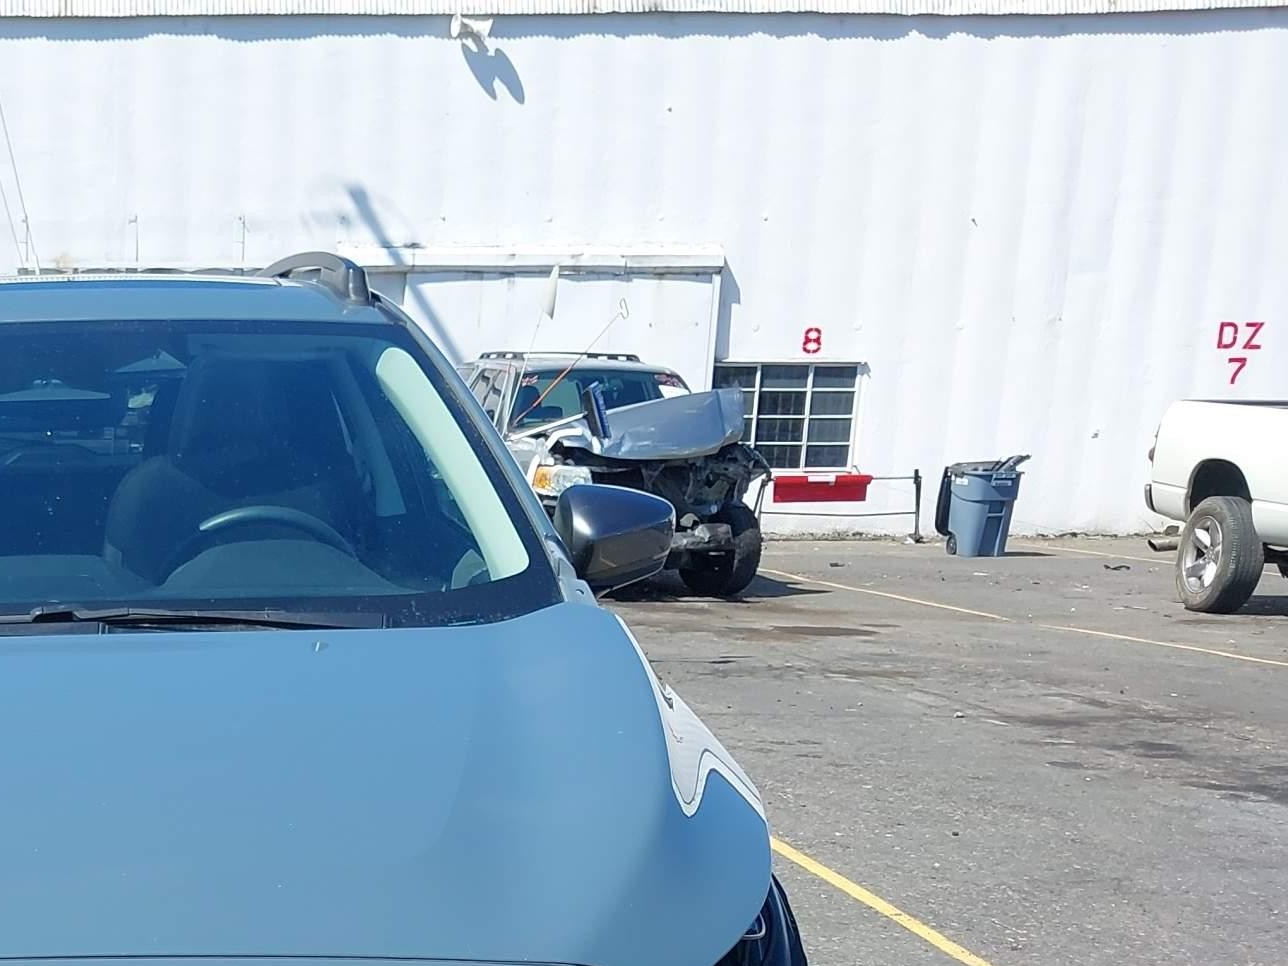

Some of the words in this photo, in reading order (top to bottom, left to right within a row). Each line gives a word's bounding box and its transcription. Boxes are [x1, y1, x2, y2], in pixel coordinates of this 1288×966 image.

[802, 327, 822, 354] 8
[1217, 321, 1265, 349] DZ
[1228, 357, 1248, 385] 7
